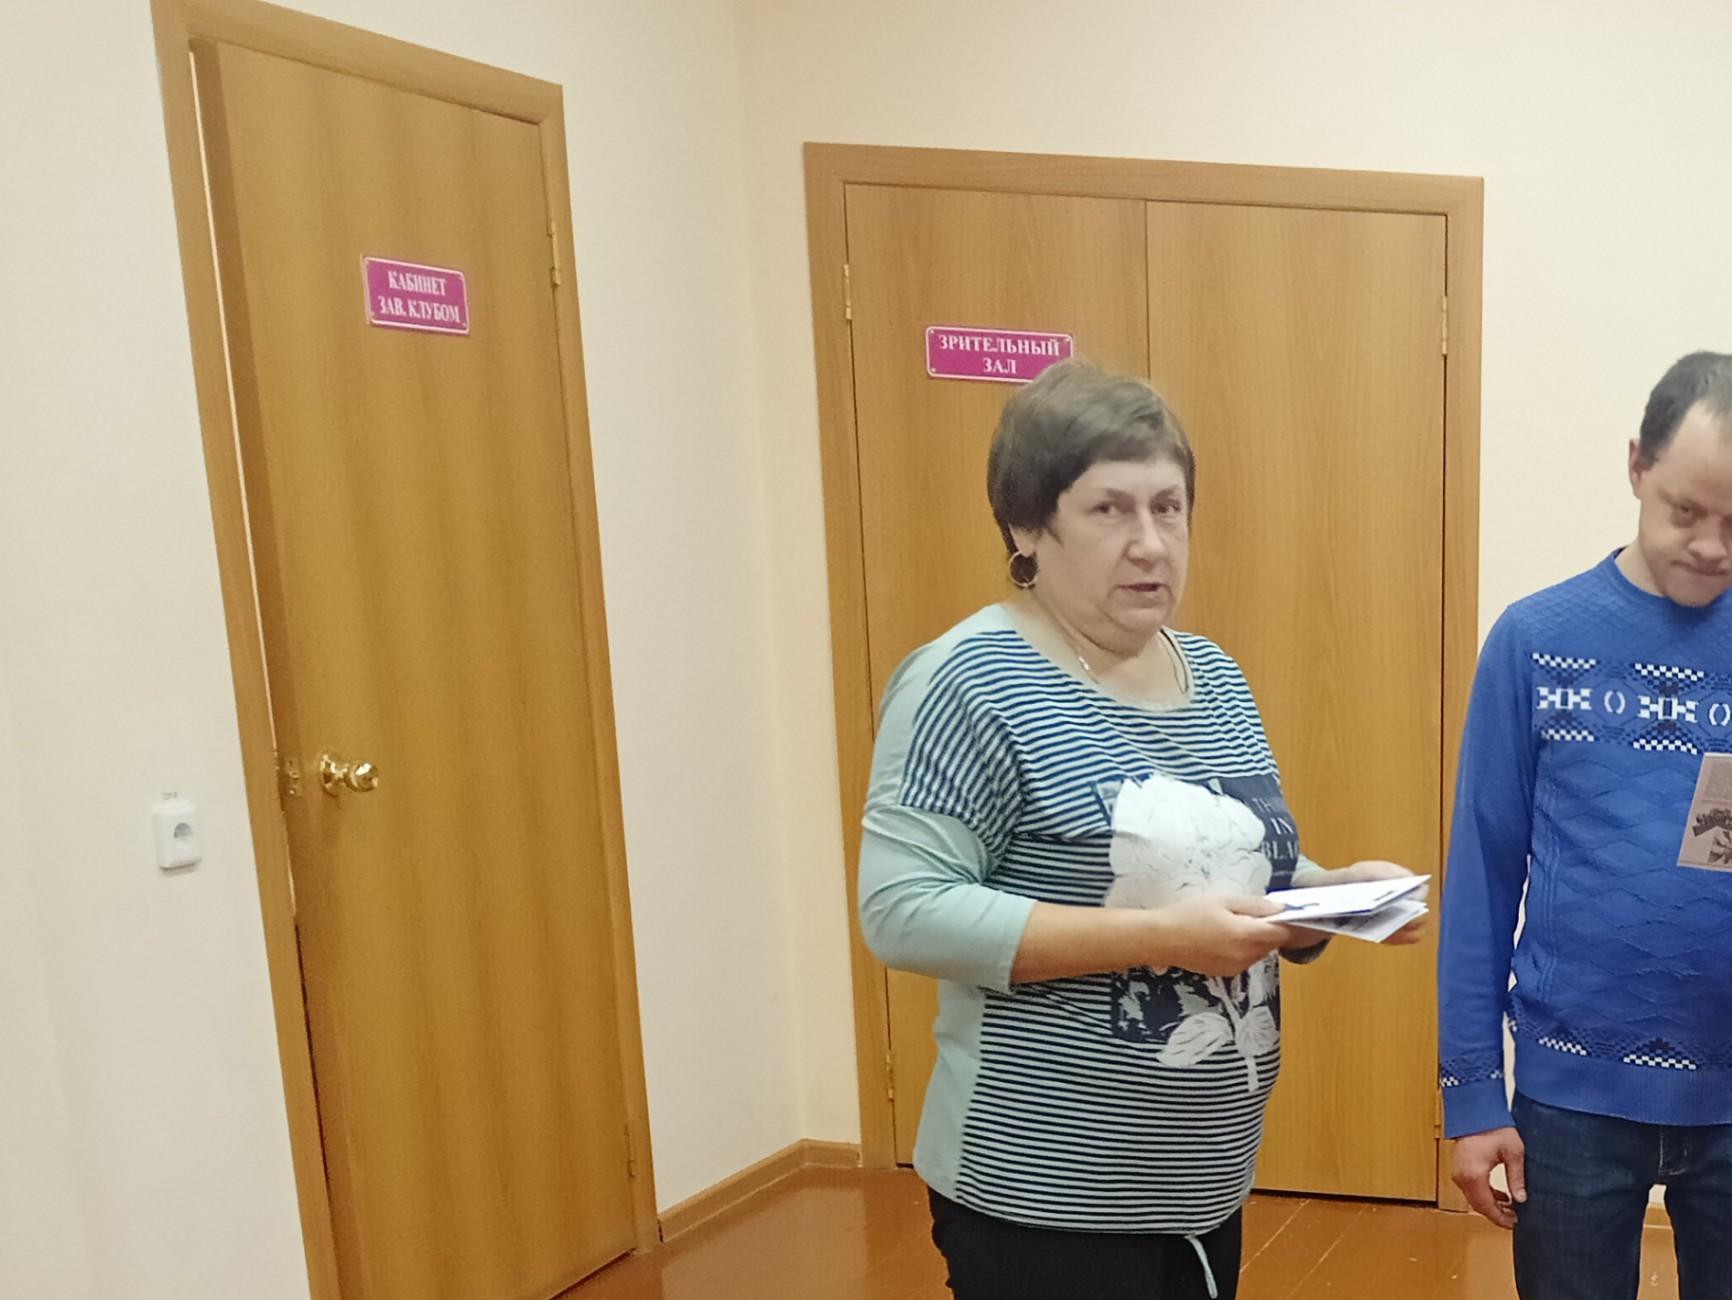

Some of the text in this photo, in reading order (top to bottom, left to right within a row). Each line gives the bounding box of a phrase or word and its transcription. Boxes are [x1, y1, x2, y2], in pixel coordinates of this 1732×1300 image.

[387, 270, 447, 296] КАБИНЕТ
[378, 296, 461, 323] ЗАВ. КЛУБОМ
[938, 334, 1061, 356] ЗРИТЕЛЬНЫЙ
[982, 357, 1018, 374] ЗАЛ
